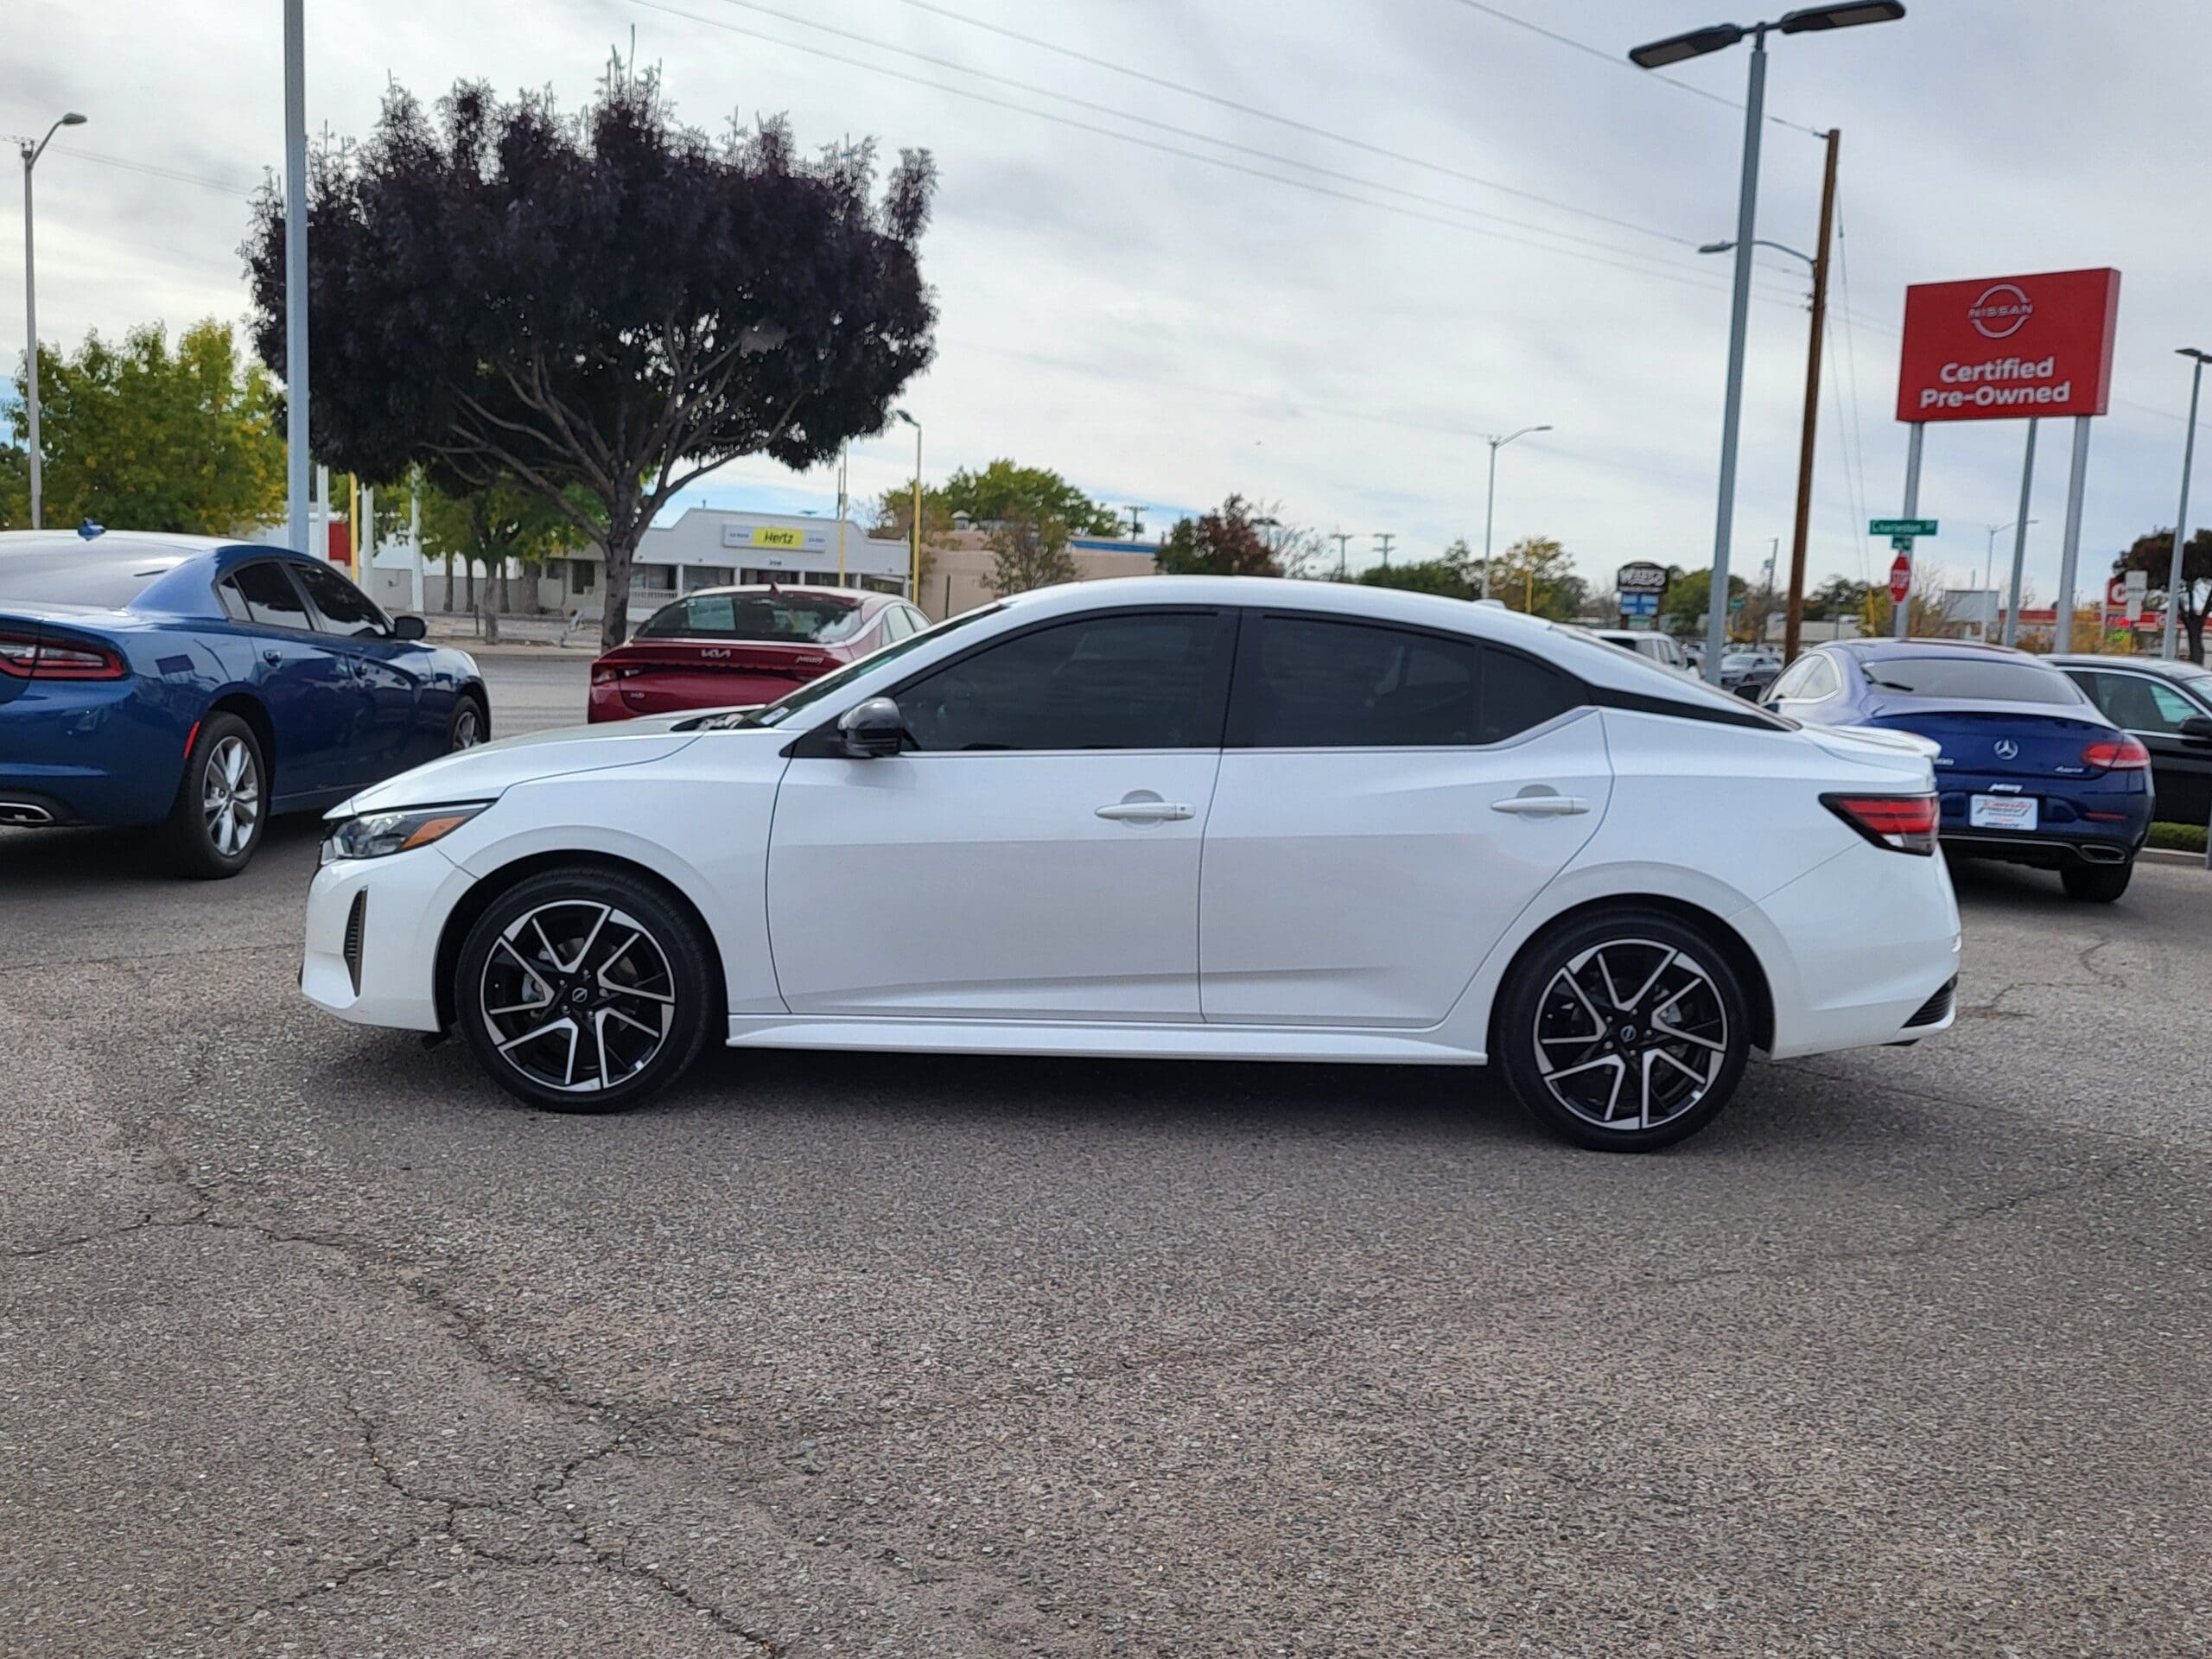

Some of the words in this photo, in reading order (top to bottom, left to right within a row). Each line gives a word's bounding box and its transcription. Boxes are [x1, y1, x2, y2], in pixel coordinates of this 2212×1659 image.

[1967, 303, 2033, 319] NISSAN
[1940, 356, 2055, 383] Certified
[1919, 380, 2071, 409] Pre-Owned
[762, 529, 794, 545] Hertz
[1890, 569, 1910, 588] STOP
[701, 649, 732, 658] KIA
